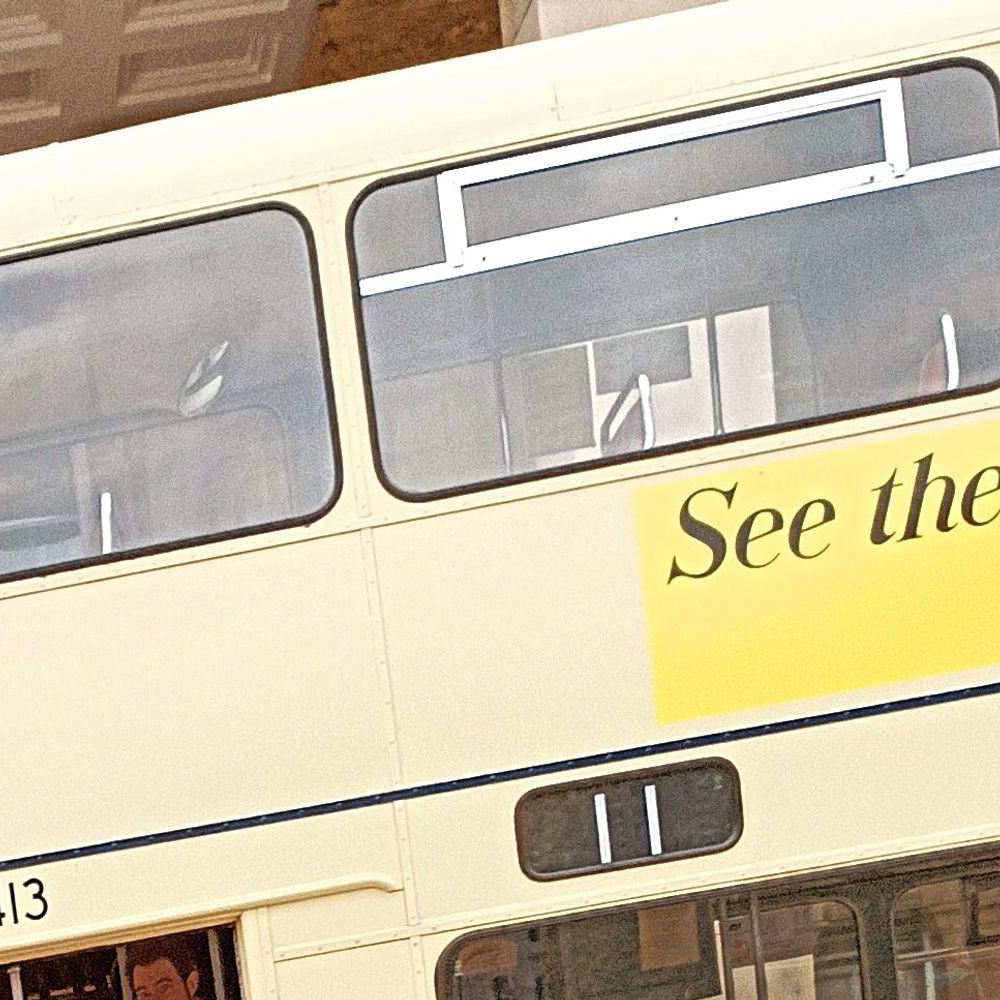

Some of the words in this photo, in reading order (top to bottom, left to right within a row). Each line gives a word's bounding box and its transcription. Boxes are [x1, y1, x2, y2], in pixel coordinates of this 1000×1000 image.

[667, 482, 836, 585] See
[869, 452, 1000, 545] the
[594, 785, 662, 863] 11
